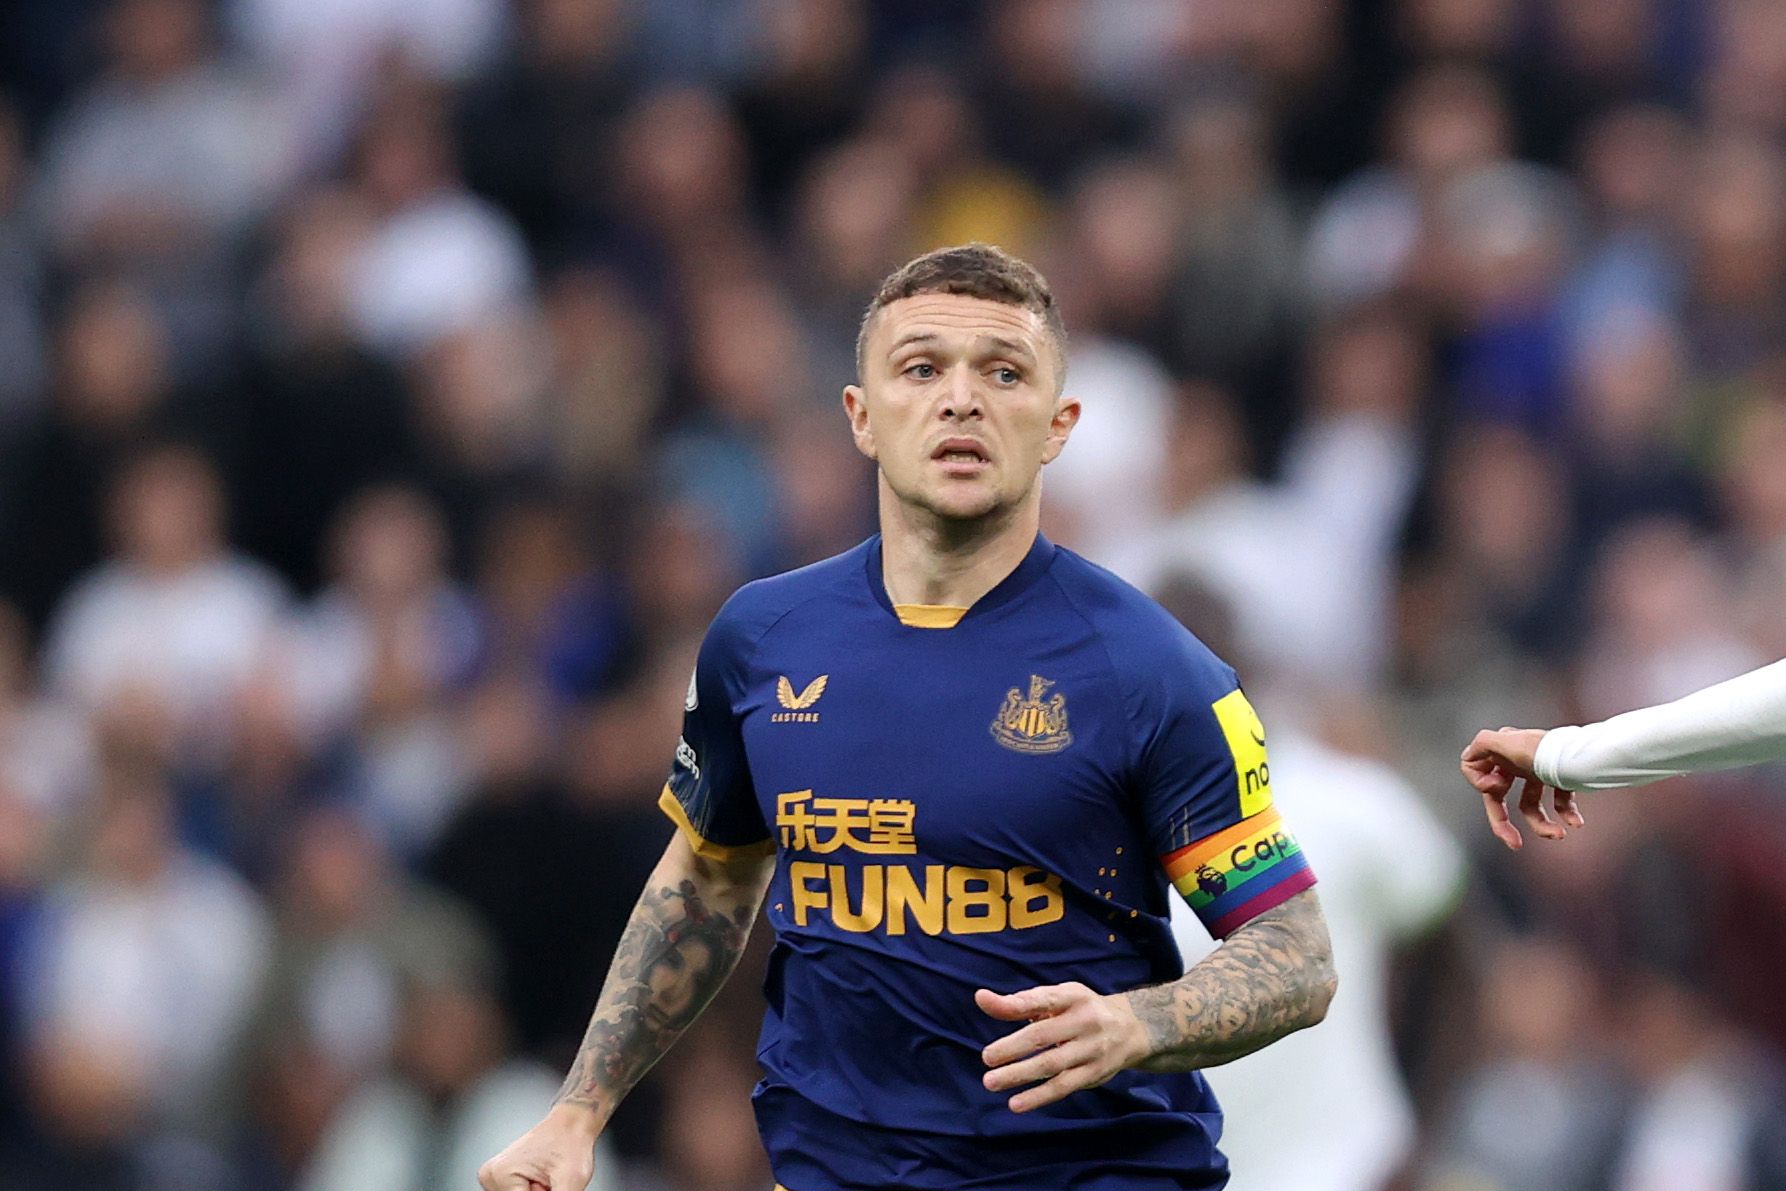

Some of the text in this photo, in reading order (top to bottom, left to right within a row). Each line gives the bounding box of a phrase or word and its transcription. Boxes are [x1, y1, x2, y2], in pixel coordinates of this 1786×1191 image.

[771, 712, 820, 723] CASTORE
[776, 788, 917, 855] 乐天堂
[1231, 832, 1298, 871] Cap
[790, 860, 1064, 936] FUN88
